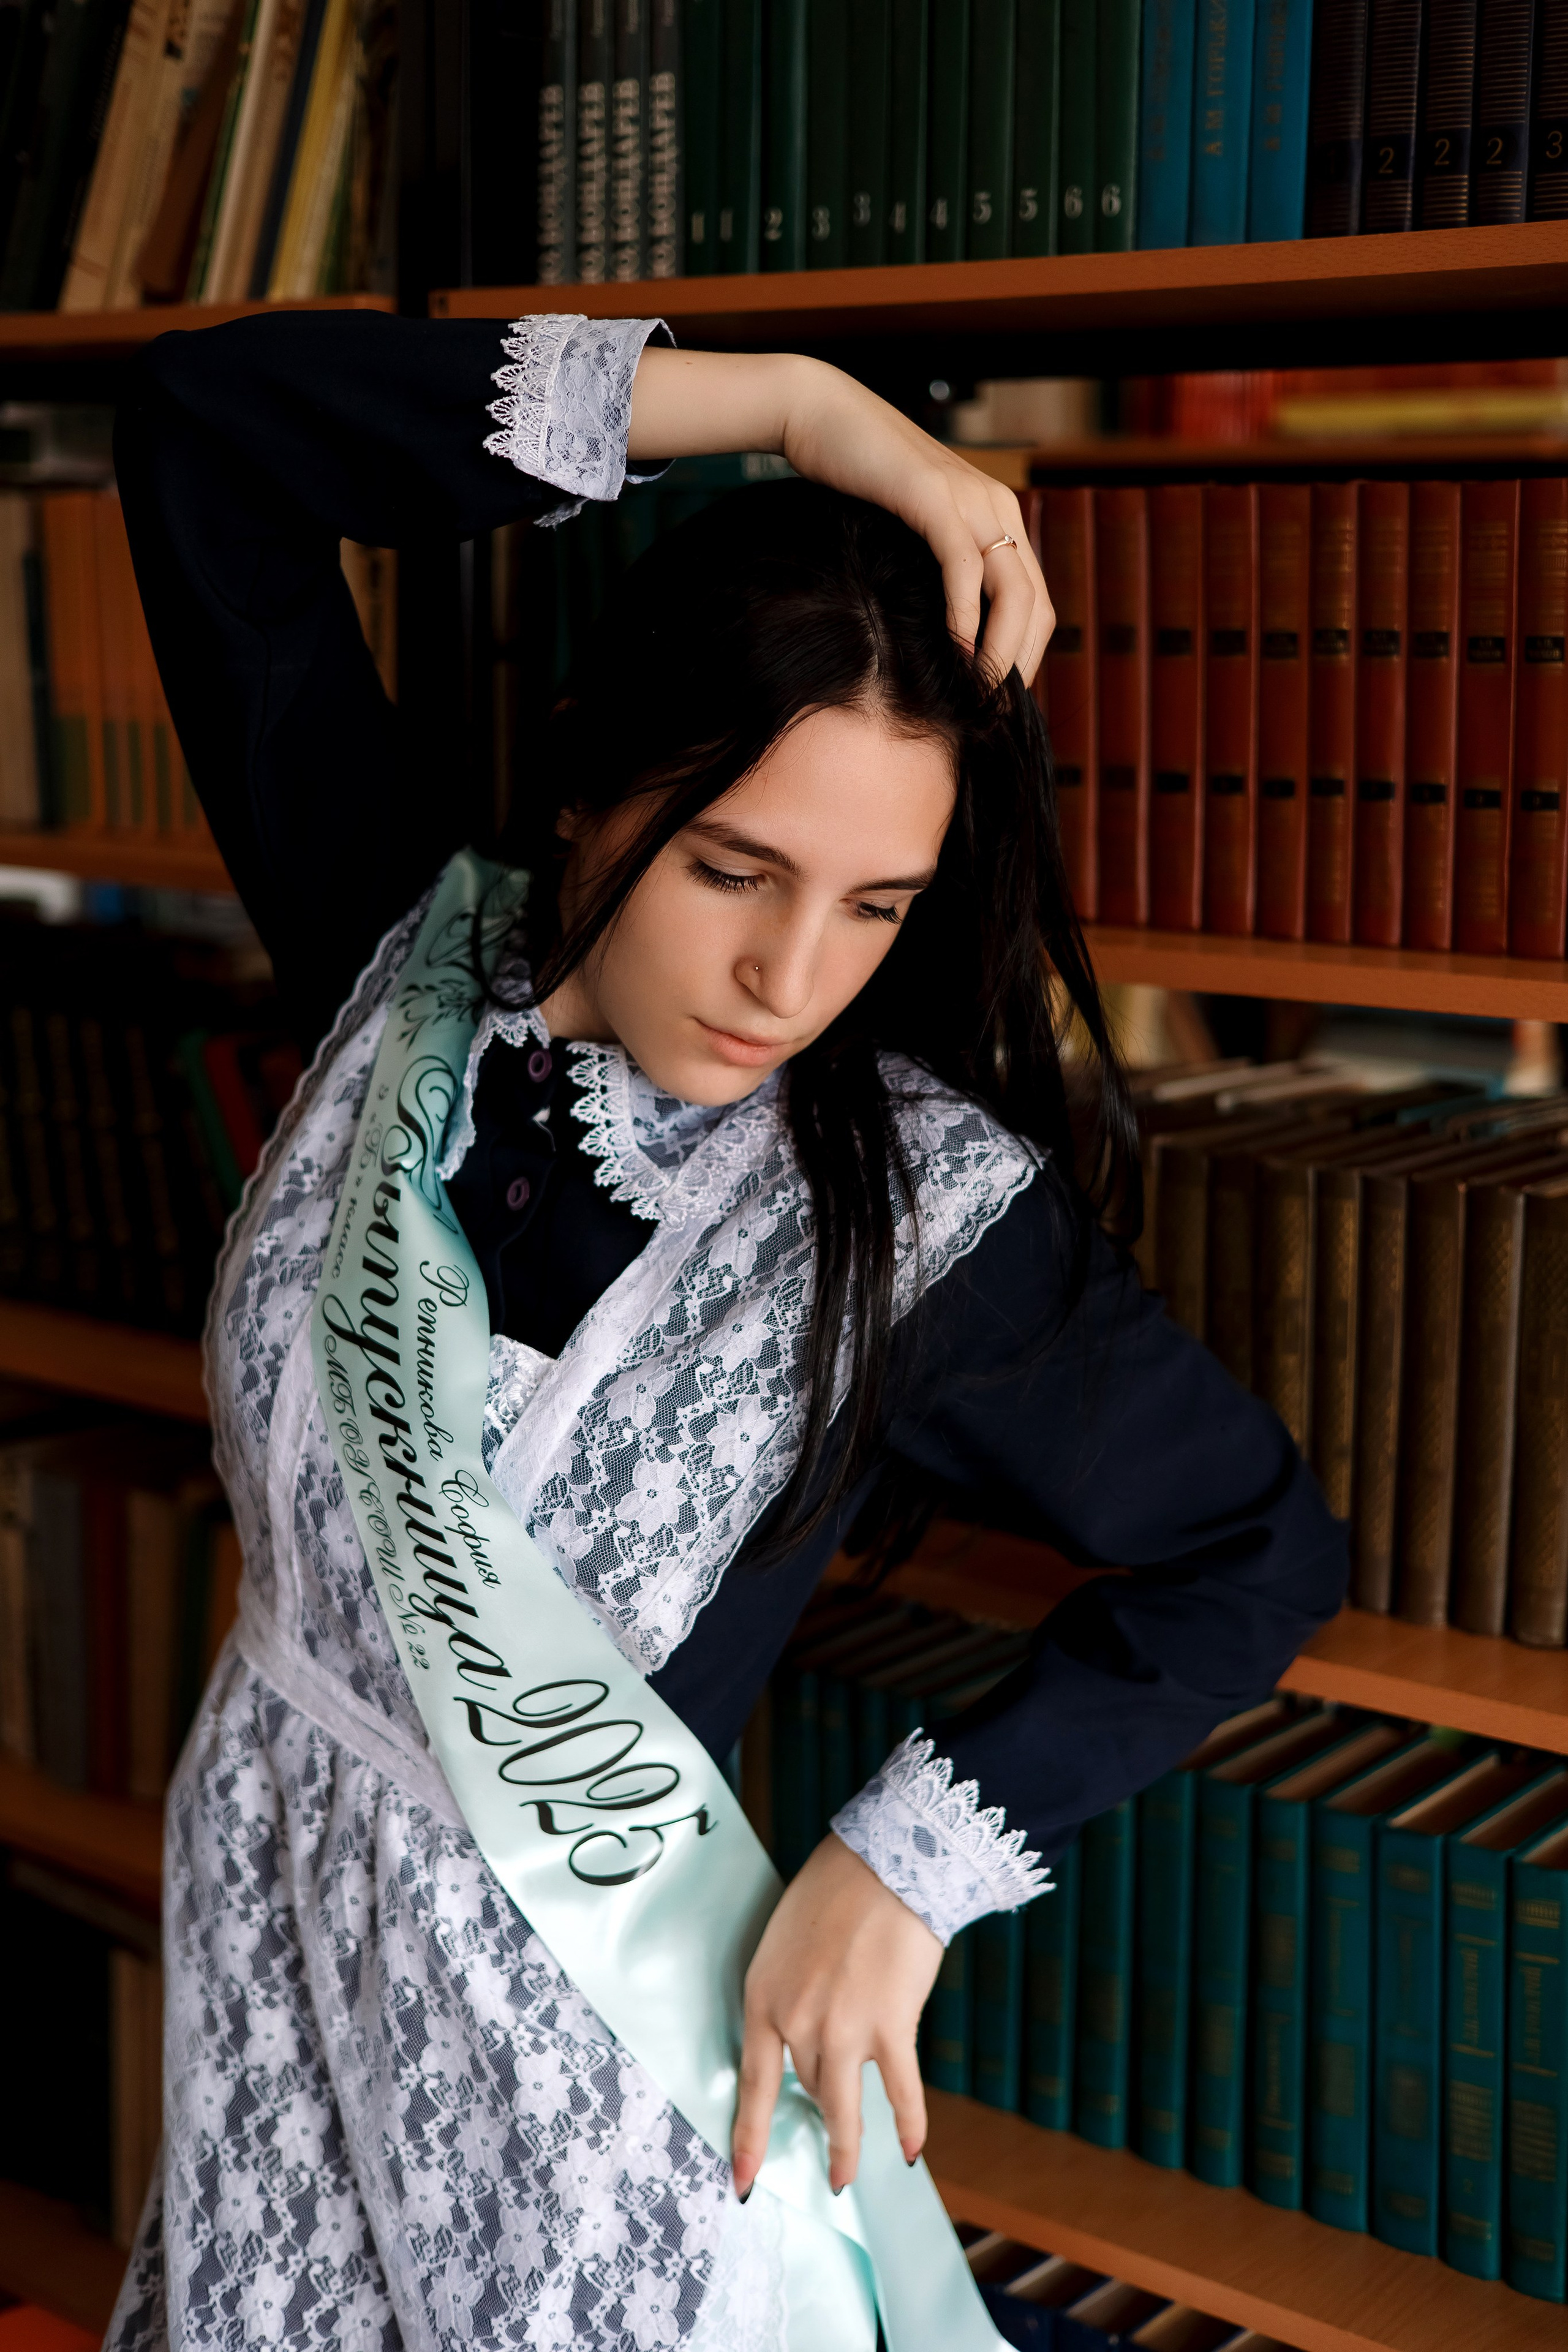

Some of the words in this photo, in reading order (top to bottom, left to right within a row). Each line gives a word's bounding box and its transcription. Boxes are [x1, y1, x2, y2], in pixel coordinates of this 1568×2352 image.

[1378, 146, 1396, 174] 2
[1434, 138, 1452, 166] 2
[1486, 137, 1504, 165] 2
[1545, 130, 1564, 159] 3
[930, 197, 948, 230] 4
[973, 191, 992, 225] 5
[1019, 187, 1038, 222] 5
[1064, 186, 1084, 220] 6
[1102, 183, 1121, 217] 6
[764, 206, 783, 241] 2
[331, 1196, 358, 1280] класс
[417, 1259, 470, 1462] Репникова
[322, 1055, 513, 1691] Выпускница
[453, 1678, 718, 1886] 2025
[439, 1469, 502, 1589] София
[358, 1482, 407, 1581] СОШ
[407, 1640, 431, 1671] 22
